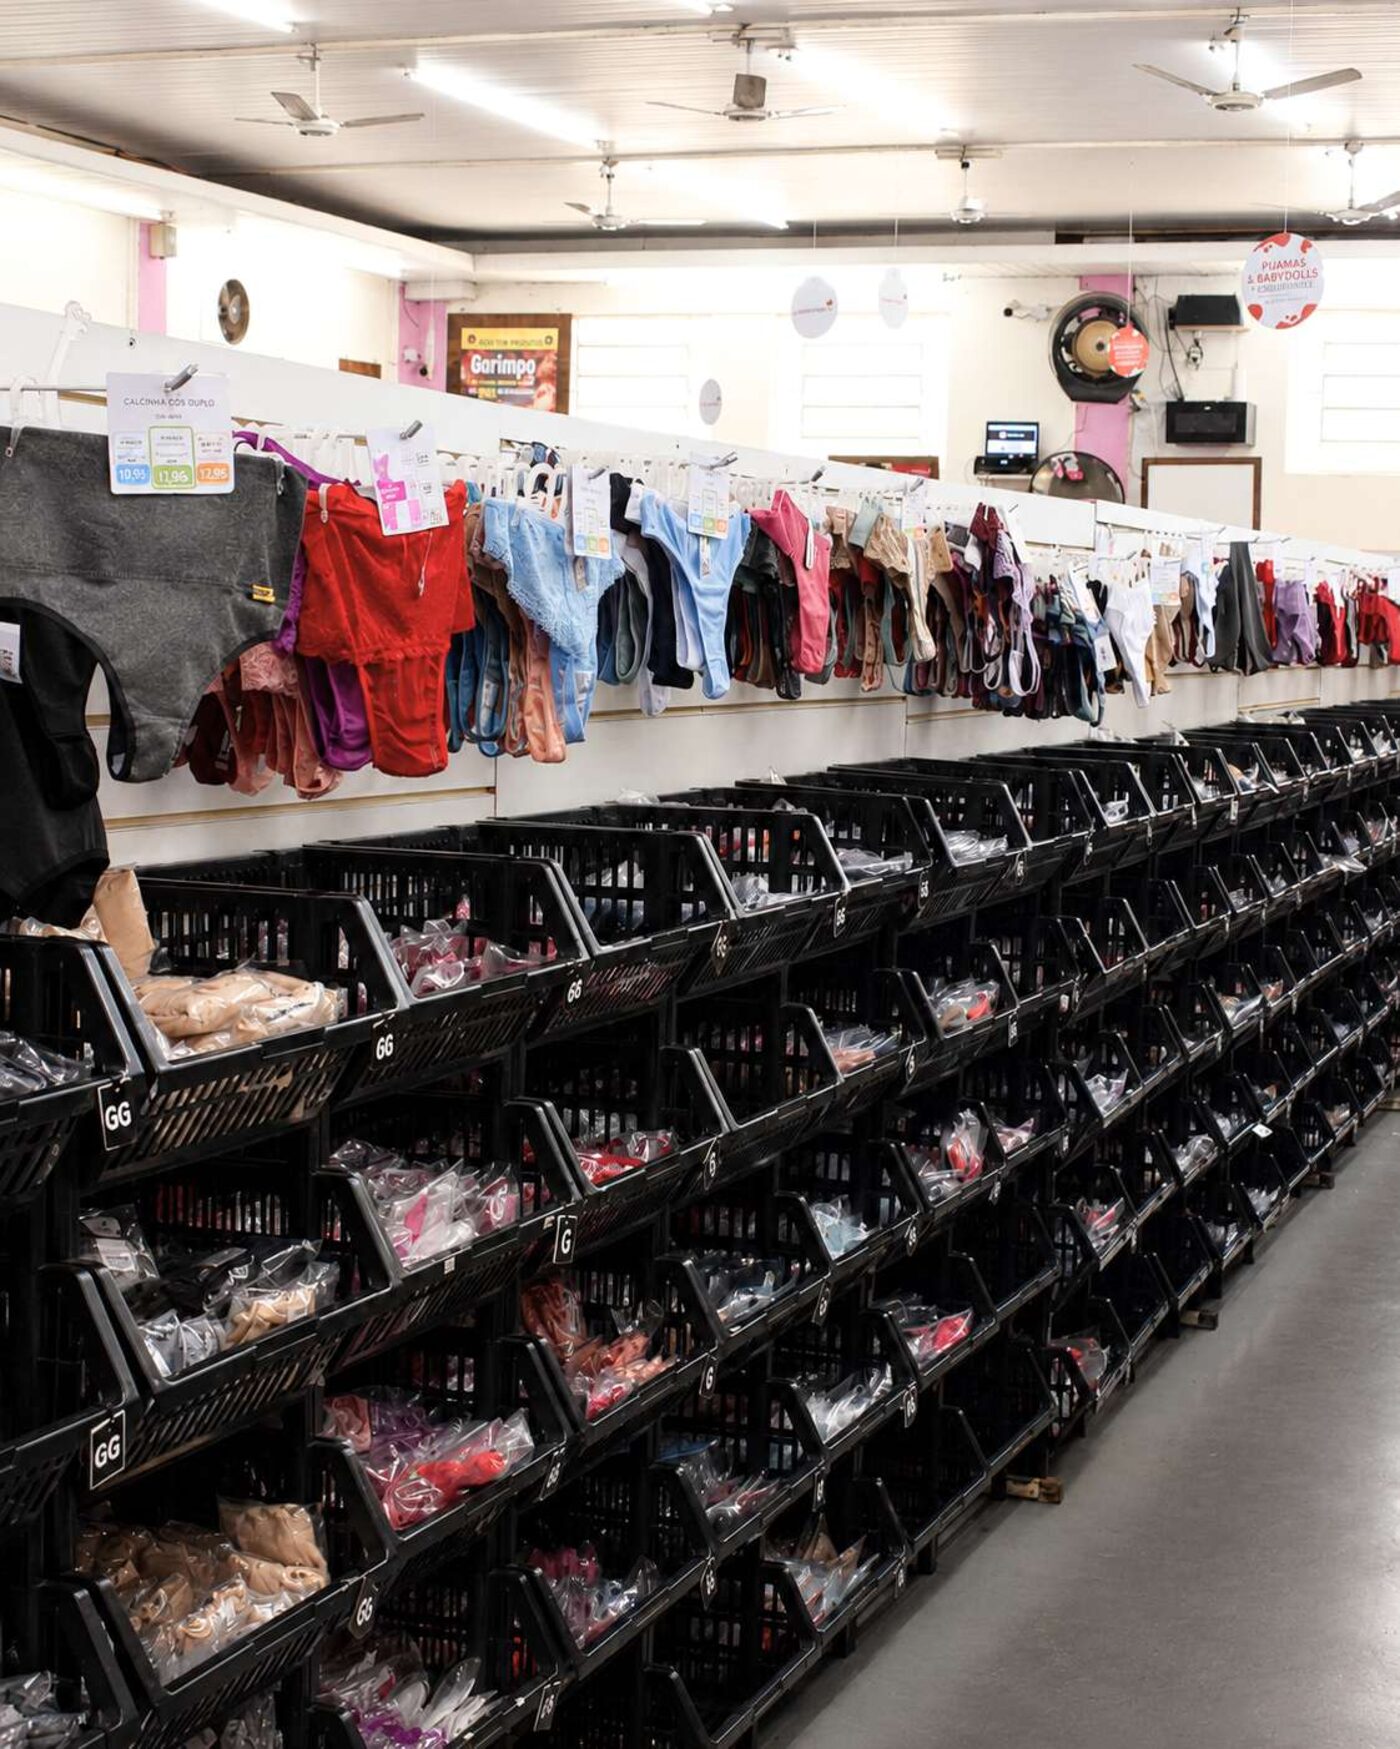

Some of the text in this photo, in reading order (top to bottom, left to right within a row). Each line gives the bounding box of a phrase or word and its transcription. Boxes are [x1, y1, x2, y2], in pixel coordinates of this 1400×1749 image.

[1256, 267, 1319, 284] BABYDOLLS
[470, 353, 536, 381] Garimpo
[123, 397, 166, 407] CALCINHA
[376, 1033, 394, 1060] GG
[105, 1101, 132, 1131] GG
[561, 1229, 572, 1254] G
[95, 1434, 121, 1469] GG
